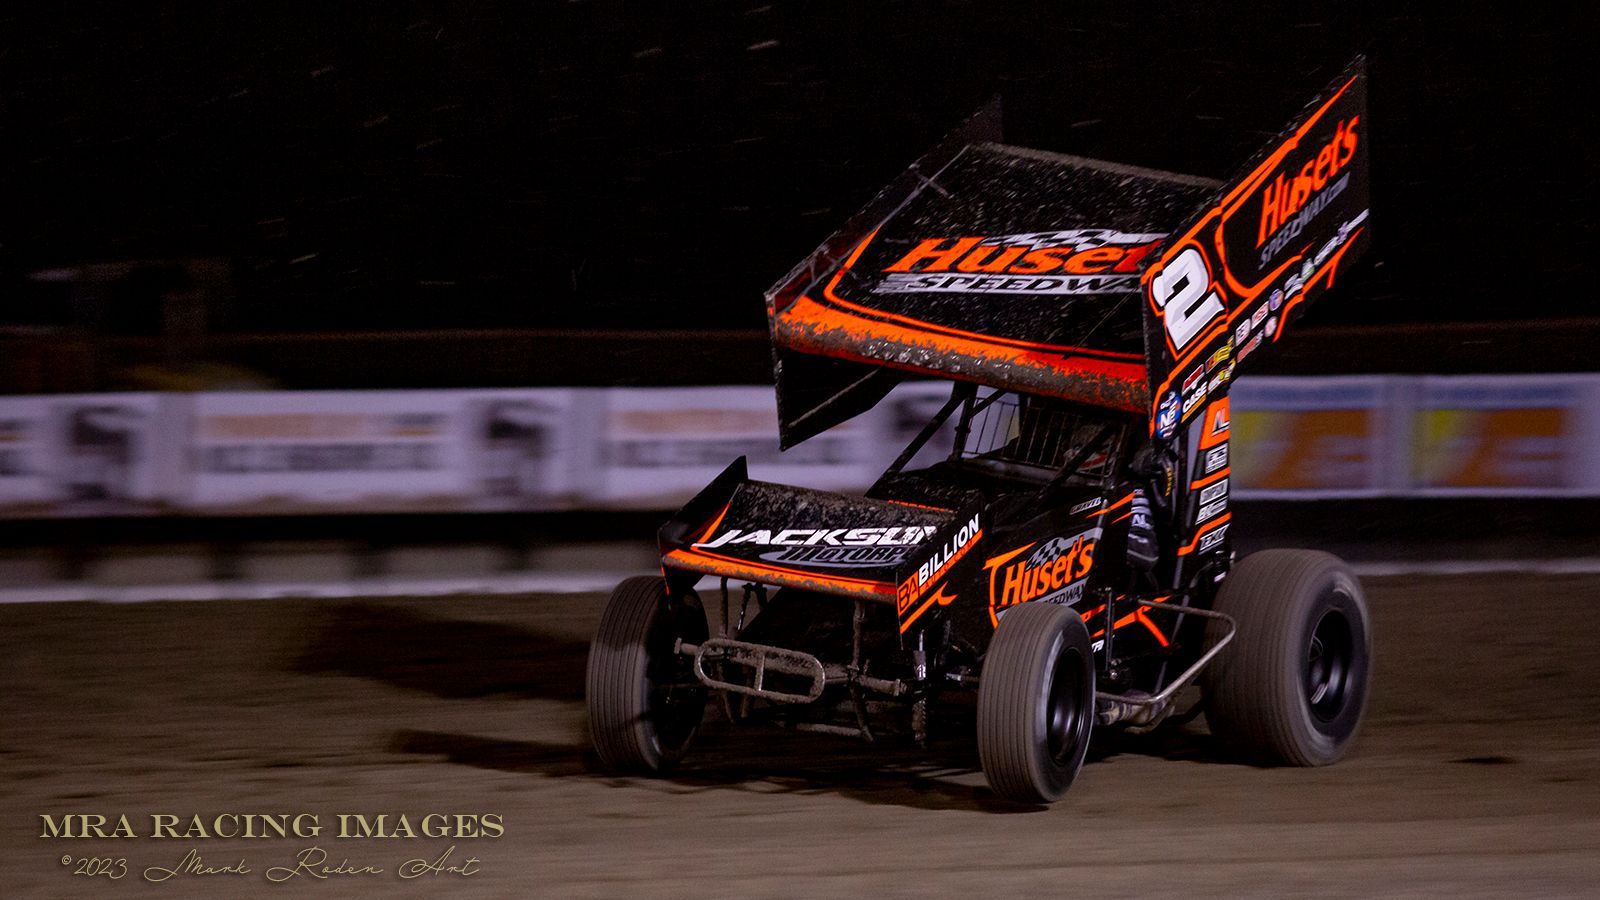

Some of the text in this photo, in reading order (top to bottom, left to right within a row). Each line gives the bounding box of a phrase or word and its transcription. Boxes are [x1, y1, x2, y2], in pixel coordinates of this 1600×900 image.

[1153, 249, 1225, 351] 2
[918, 513, 980, 587] BILLION
[1000, 535, 1096, 608] Huset's
